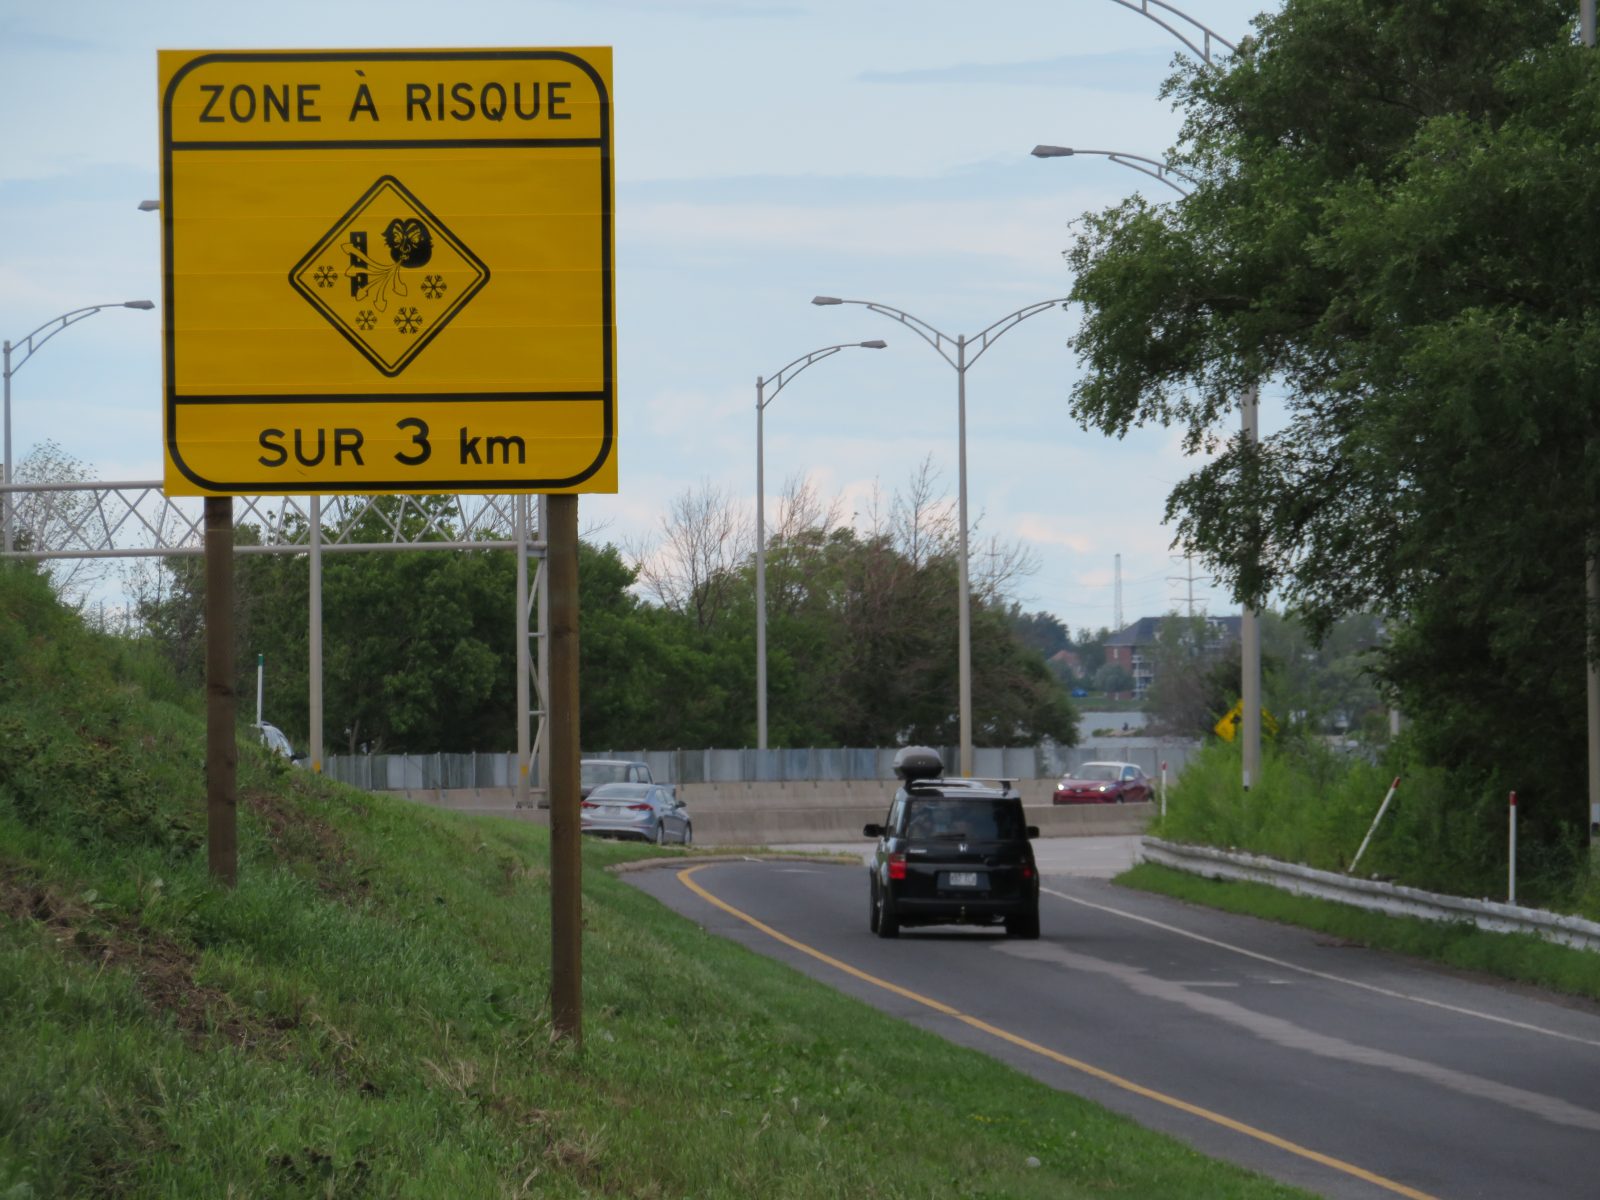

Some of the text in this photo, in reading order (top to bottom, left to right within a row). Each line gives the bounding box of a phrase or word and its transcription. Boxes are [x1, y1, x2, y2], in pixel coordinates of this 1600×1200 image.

[199, 70, 572, 123] ZONE À RISQUE
[258, 417, 526, 468] SUR 3 km
